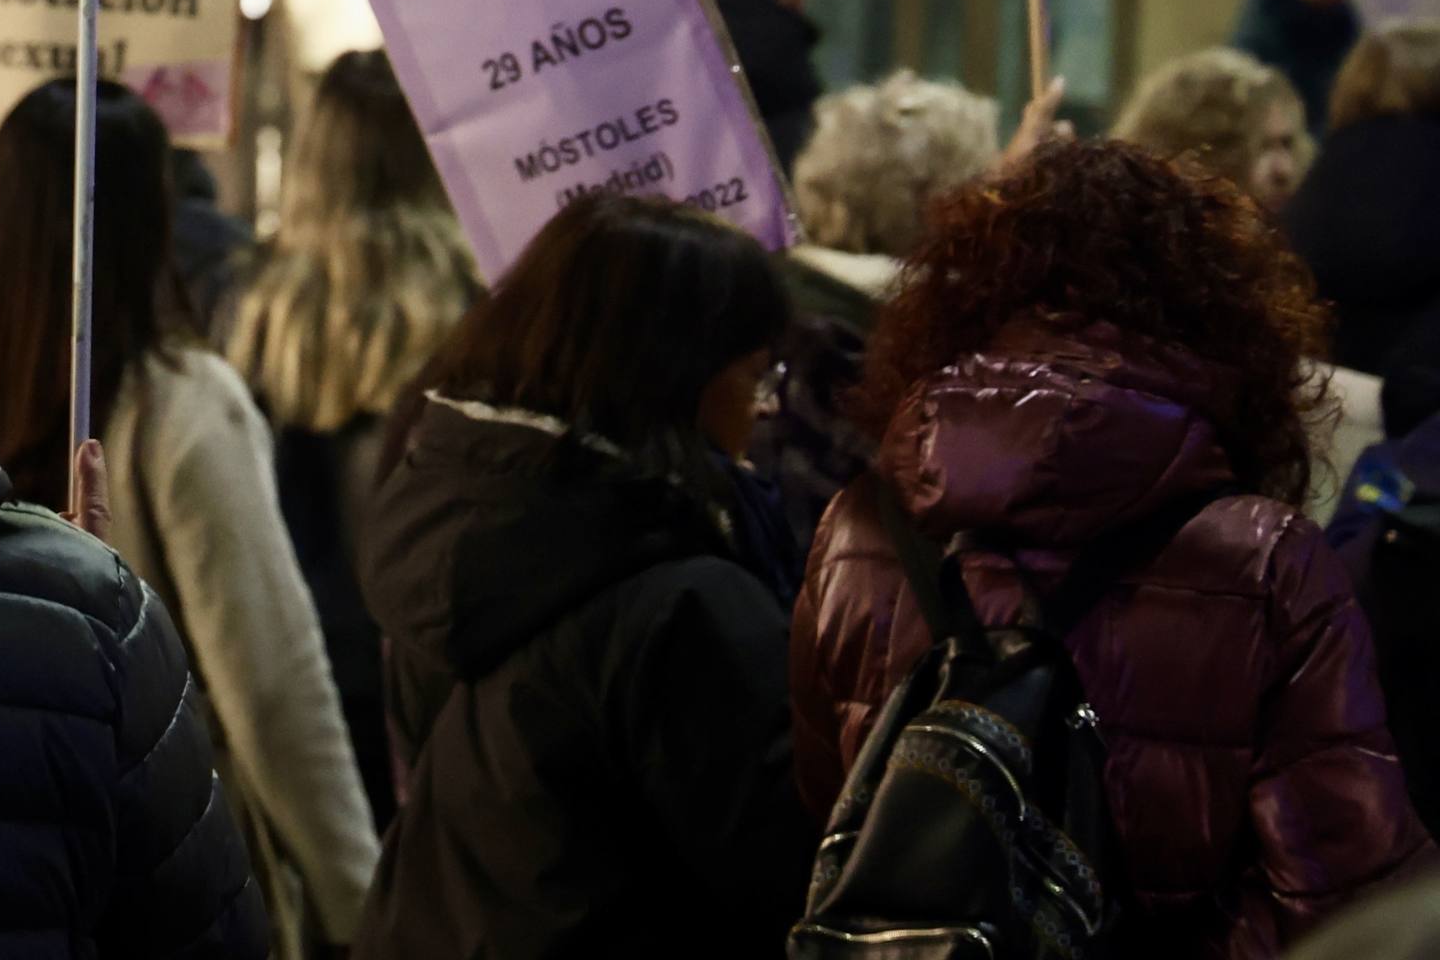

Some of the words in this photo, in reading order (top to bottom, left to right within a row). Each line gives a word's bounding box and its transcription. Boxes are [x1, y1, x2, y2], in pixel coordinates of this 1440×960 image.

[481, 52, 521, 91] 29
[532, 6, 632, 73] AÑOS
[514, 98, 679, 181] MÓSTOLES
